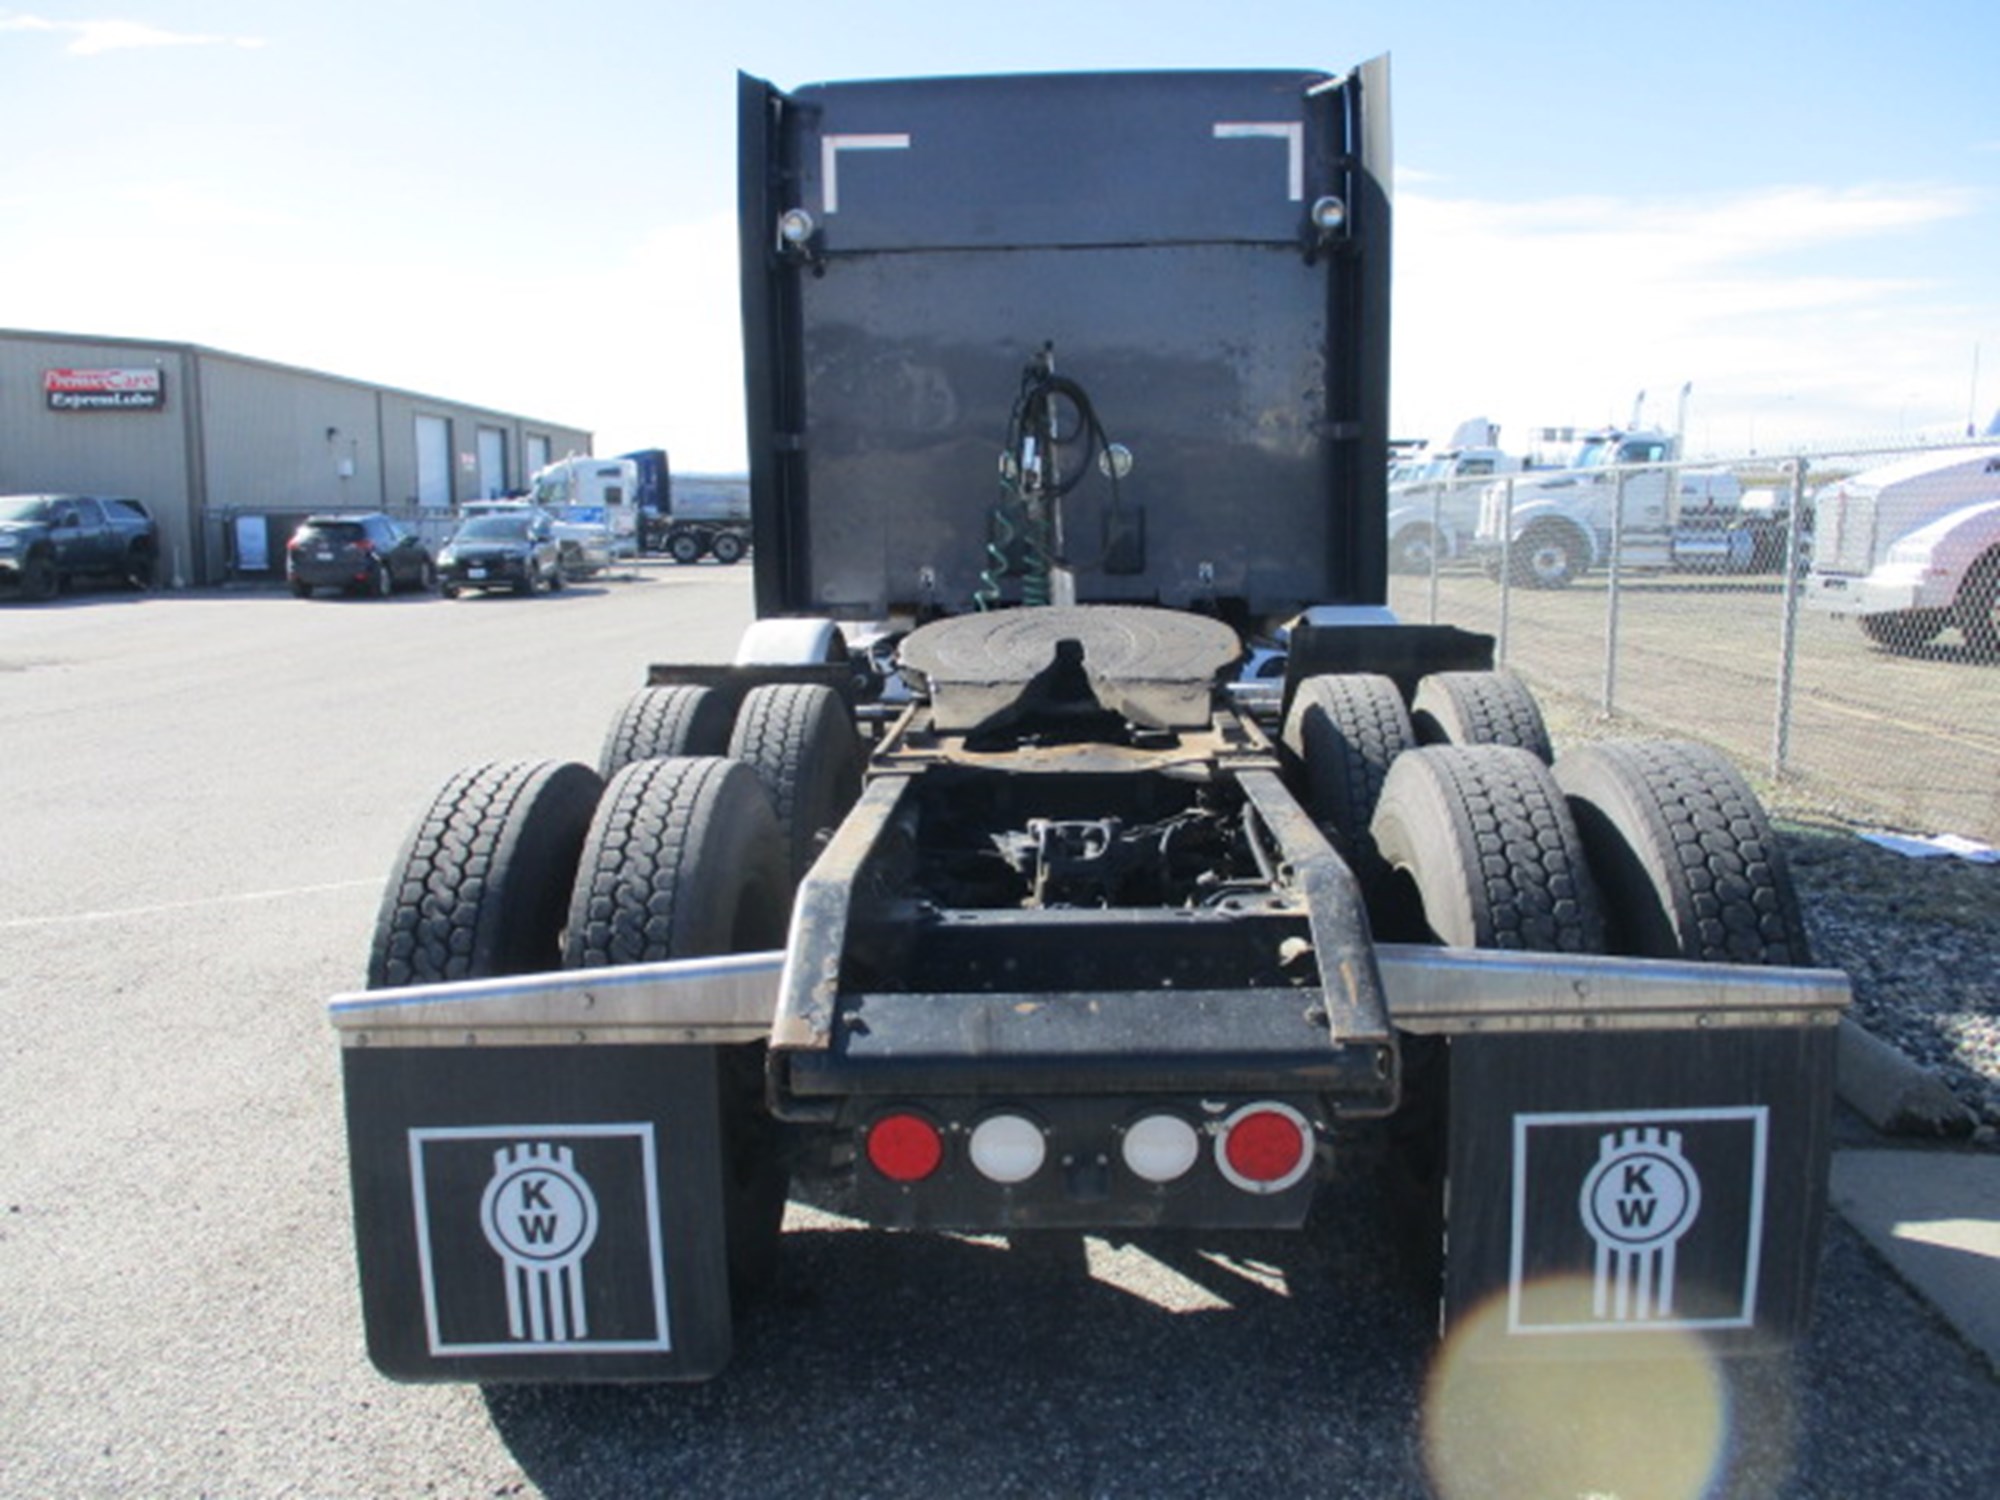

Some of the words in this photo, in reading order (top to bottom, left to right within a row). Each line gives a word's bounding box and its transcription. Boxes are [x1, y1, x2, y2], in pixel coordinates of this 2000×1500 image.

[1624, 1164, 1654, 1194] K
[521, 1180, 552, 1209] K
[1616, 1198, 1657, 1227] W
[518, 1214, 557, 1244] W
